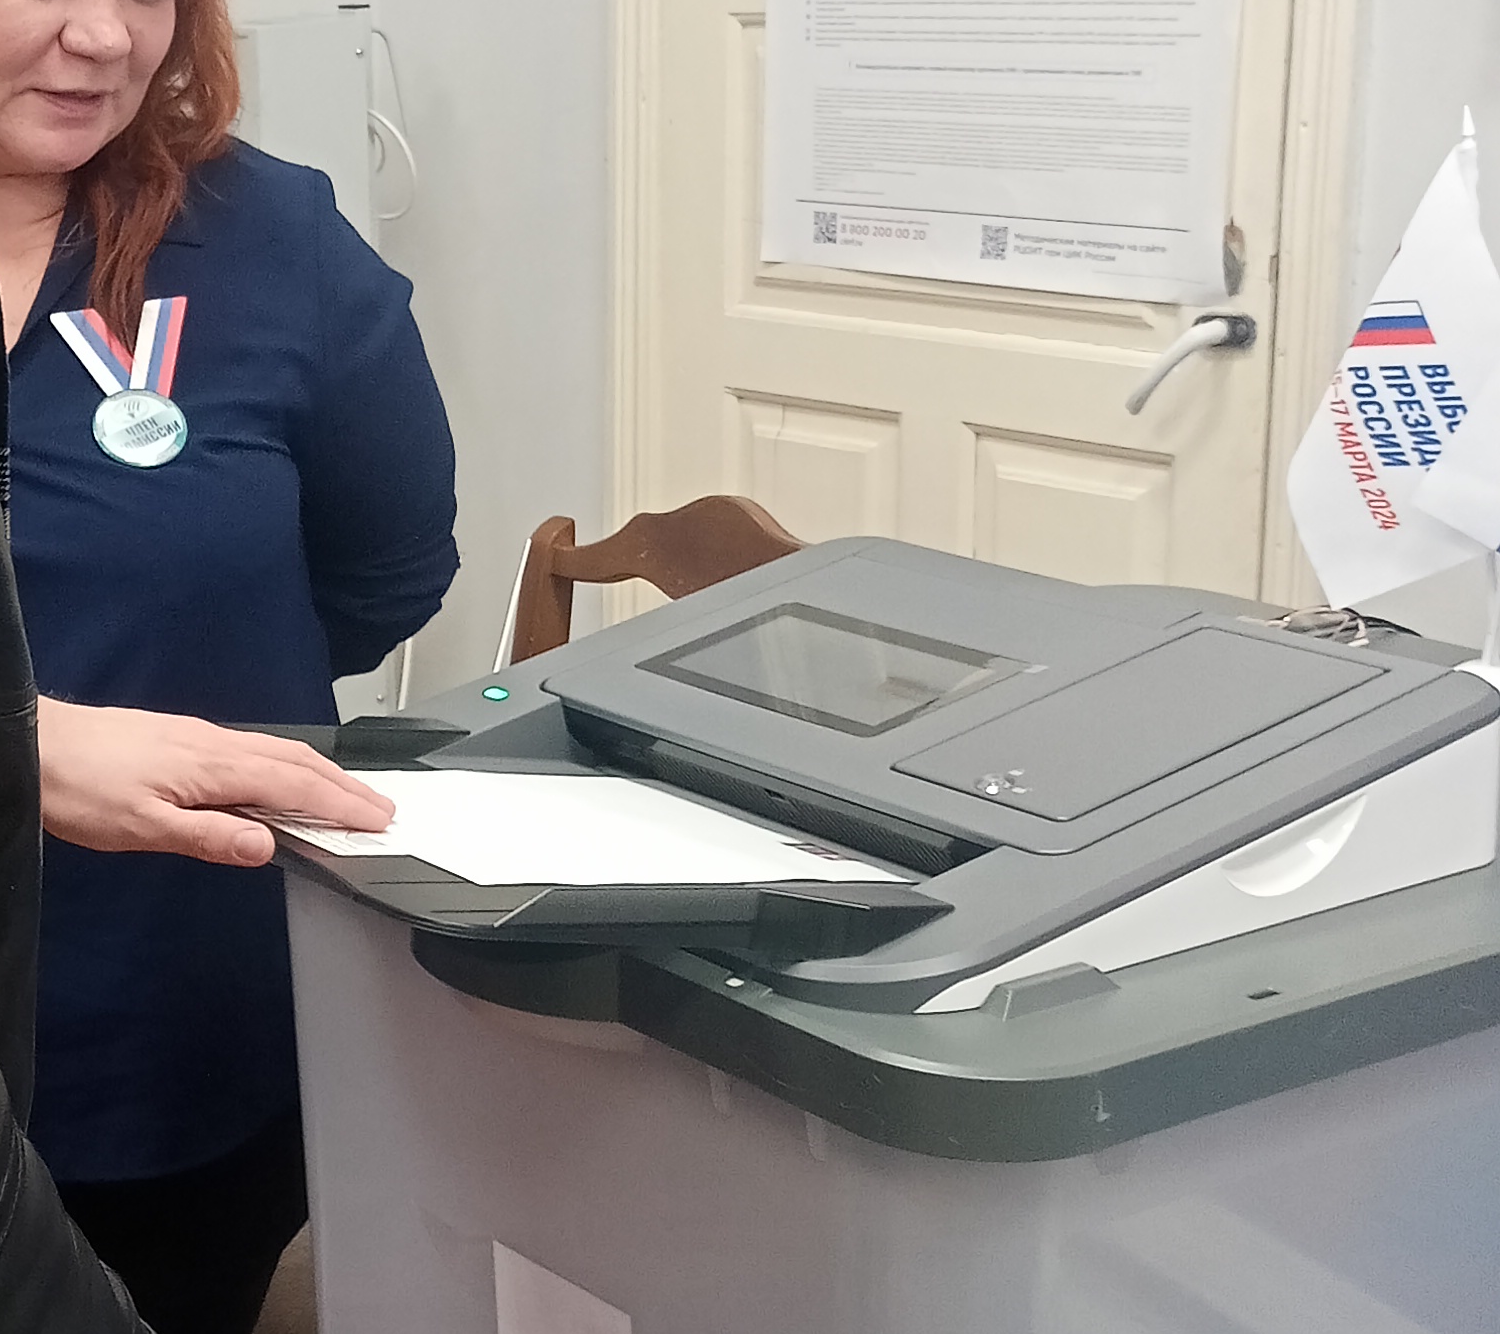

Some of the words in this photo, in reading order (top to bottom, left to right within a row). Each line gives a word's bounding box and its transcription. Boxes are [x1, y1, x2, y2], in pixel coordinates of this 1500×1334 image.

[120, 419, 182, 449] ОМИССИИ
[125, 417, 158, 436] ЧЛЕН
[1347, 366, 1411, 467] РОССИИ
[1378, 365, 1442, 473] ПРЕЗИД
[1333, 422, 1377, 483] МАРТА
[1359, 488, 1400, 530] 2024
